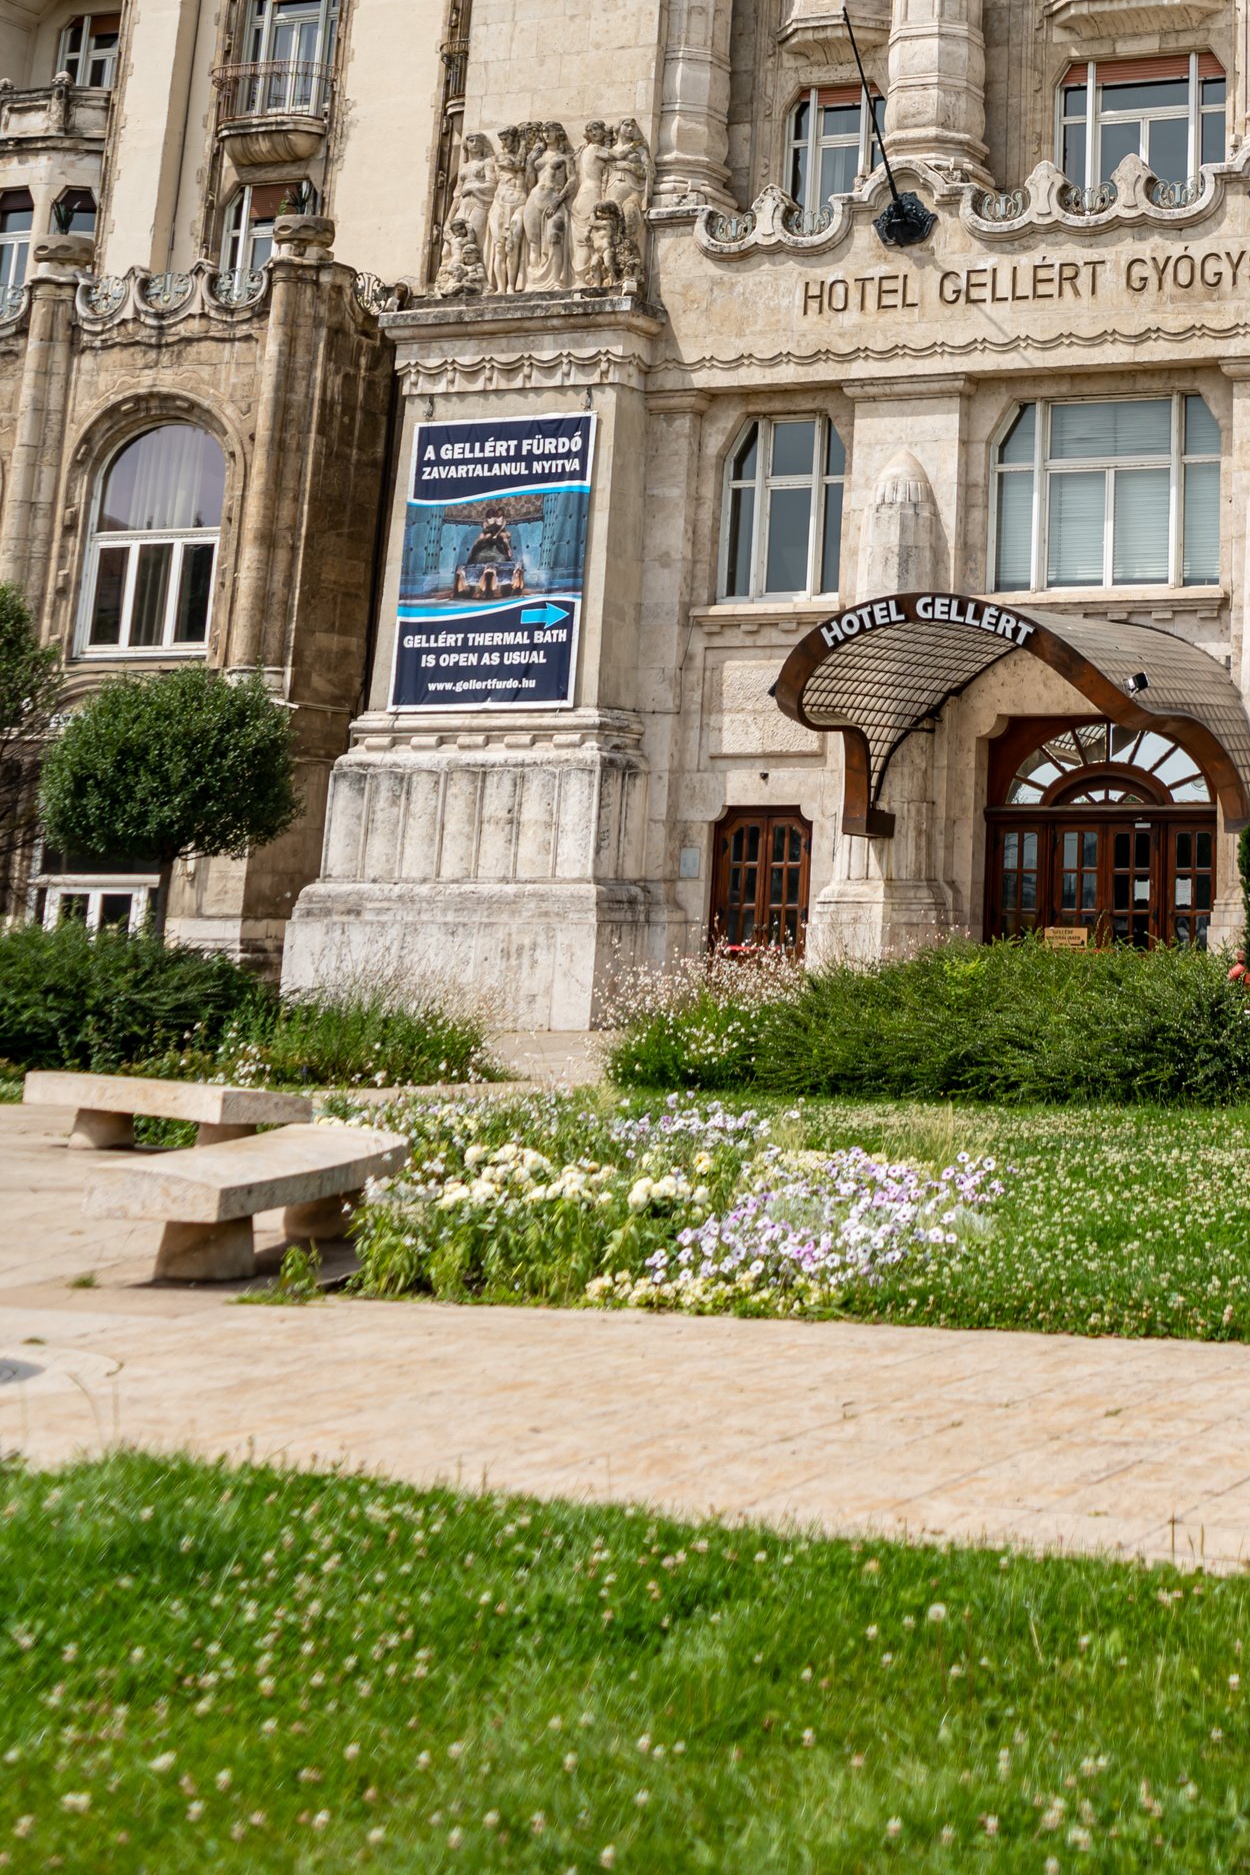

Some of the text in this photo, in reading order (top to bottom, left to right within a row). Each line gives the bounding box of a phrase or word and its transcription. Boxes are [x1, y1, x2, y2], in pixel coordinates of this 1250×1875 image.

[803, 274, 919, 316] HOTEL
[938, 255, 1105, 305] GELLÉRT
[423, 431, 583, 461] A GELLÉRT FÜRDŐ
[421, 458, 580, 480] ZAVARTALANUL NYITVA
[820, 596, 1035, 647] HOTEL GELLÉRT
[403, 629, 567, 648] GELLÉRT THERMAL BATH
[421, 650, 547, 667] IS OPEN AS USUAL
[427, 678, 536, 692] www.gellertfurdo.hu
